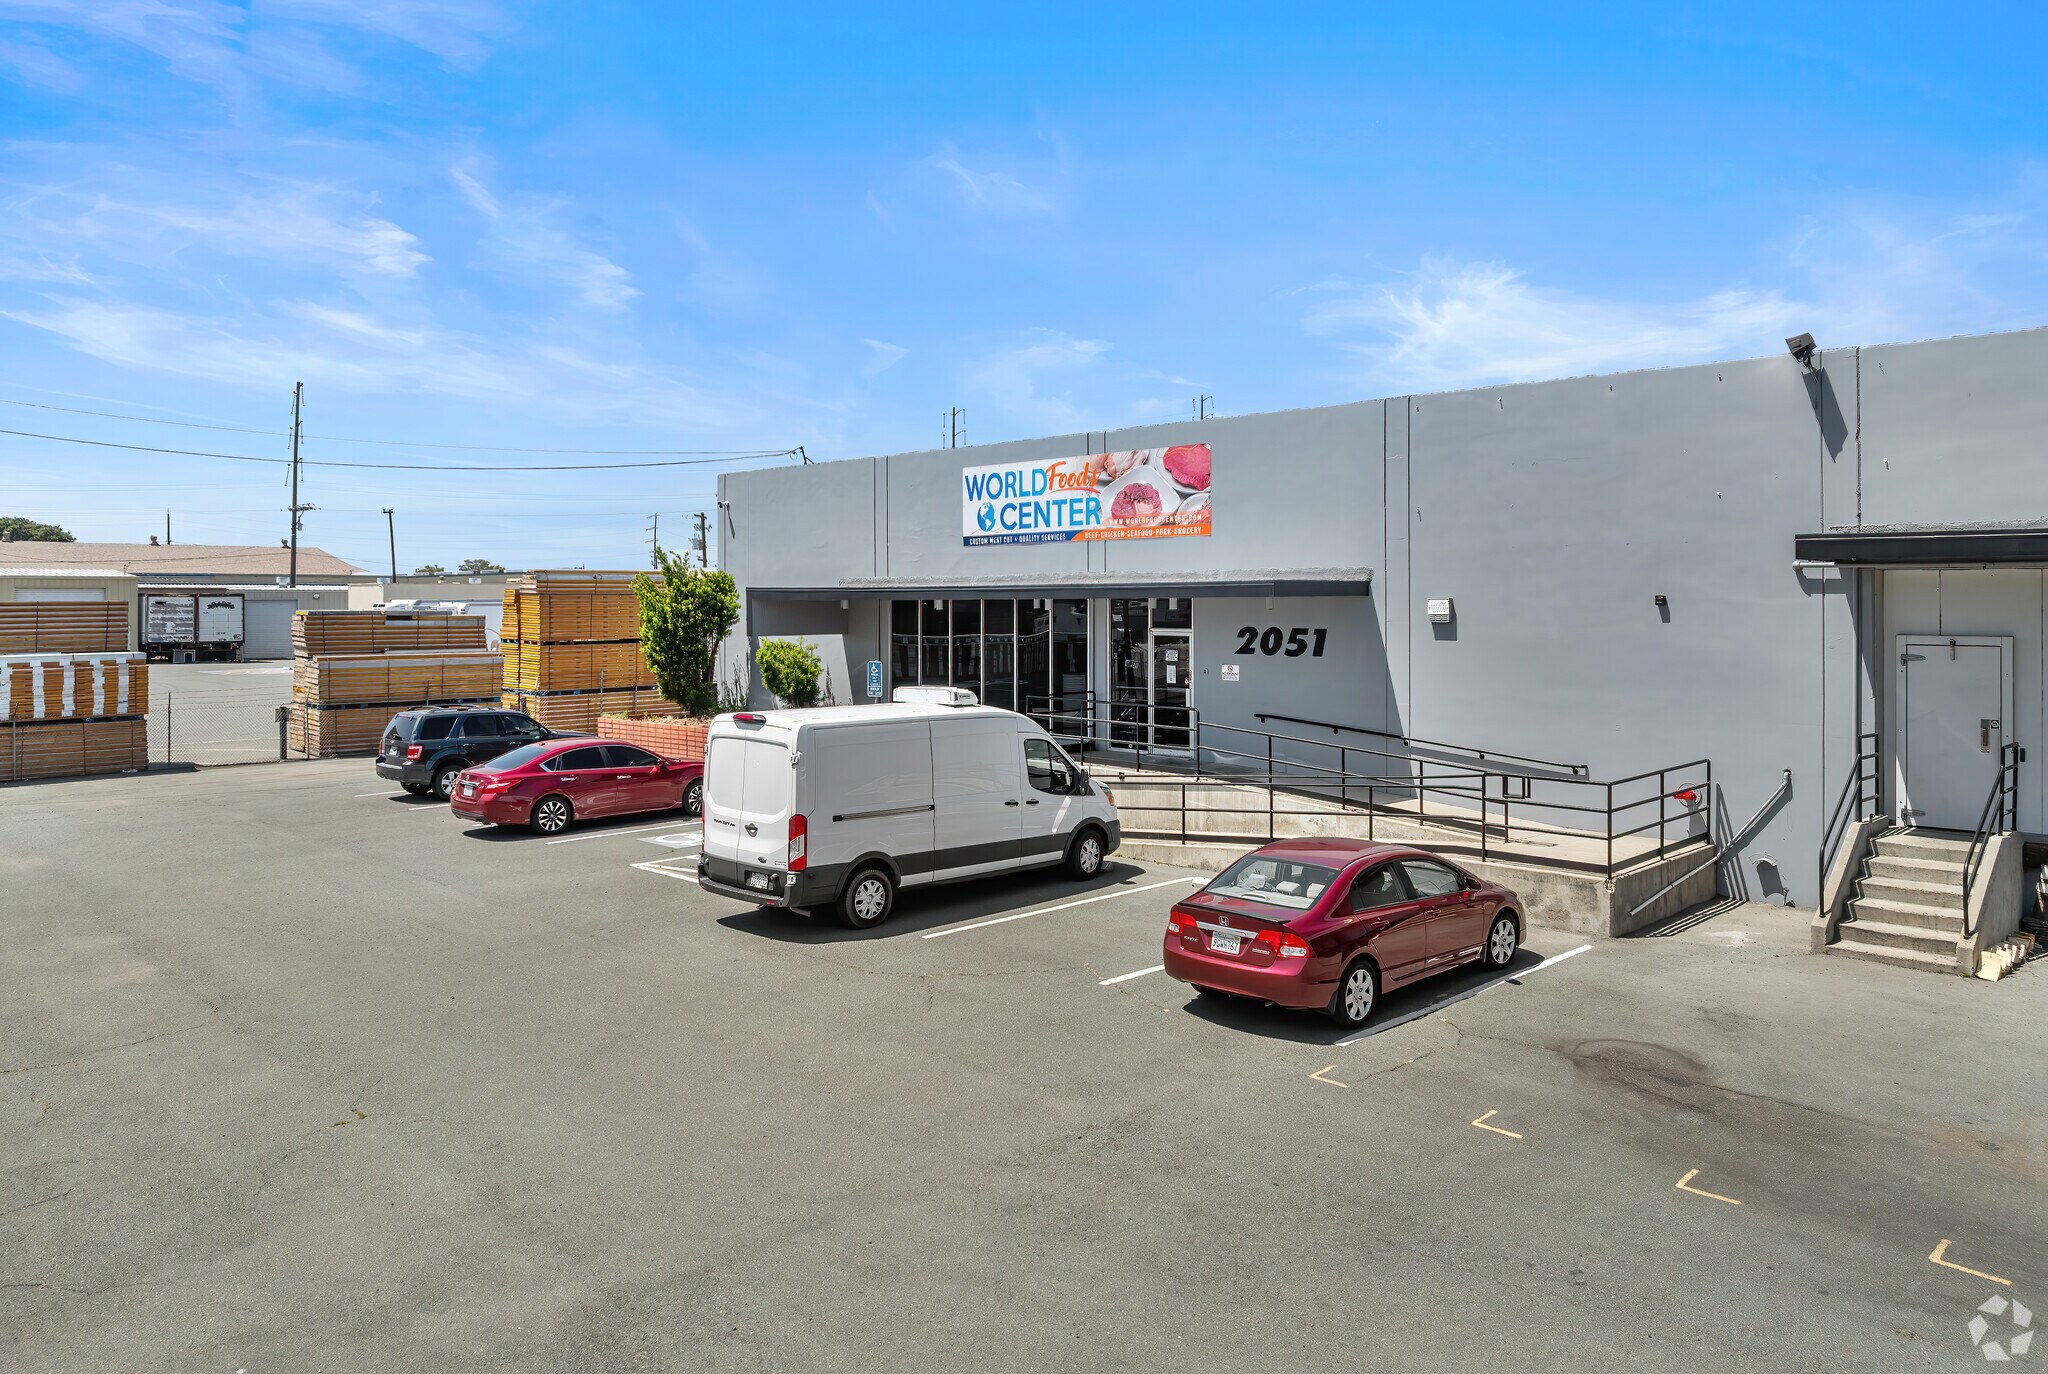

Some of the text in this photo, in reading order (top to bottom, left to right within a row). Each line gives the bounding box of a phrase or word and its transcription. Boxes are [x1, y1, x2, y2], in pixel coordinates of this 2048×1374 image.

[965, 460, 1099, 502] WORLD Foods
[999, 497, 1101, 531] CENTER
[969, 532, 1066, 545] CUSTOM MEAT CUT QUALITY SERVICES
[1234, 626, 1328, 657] 2051
